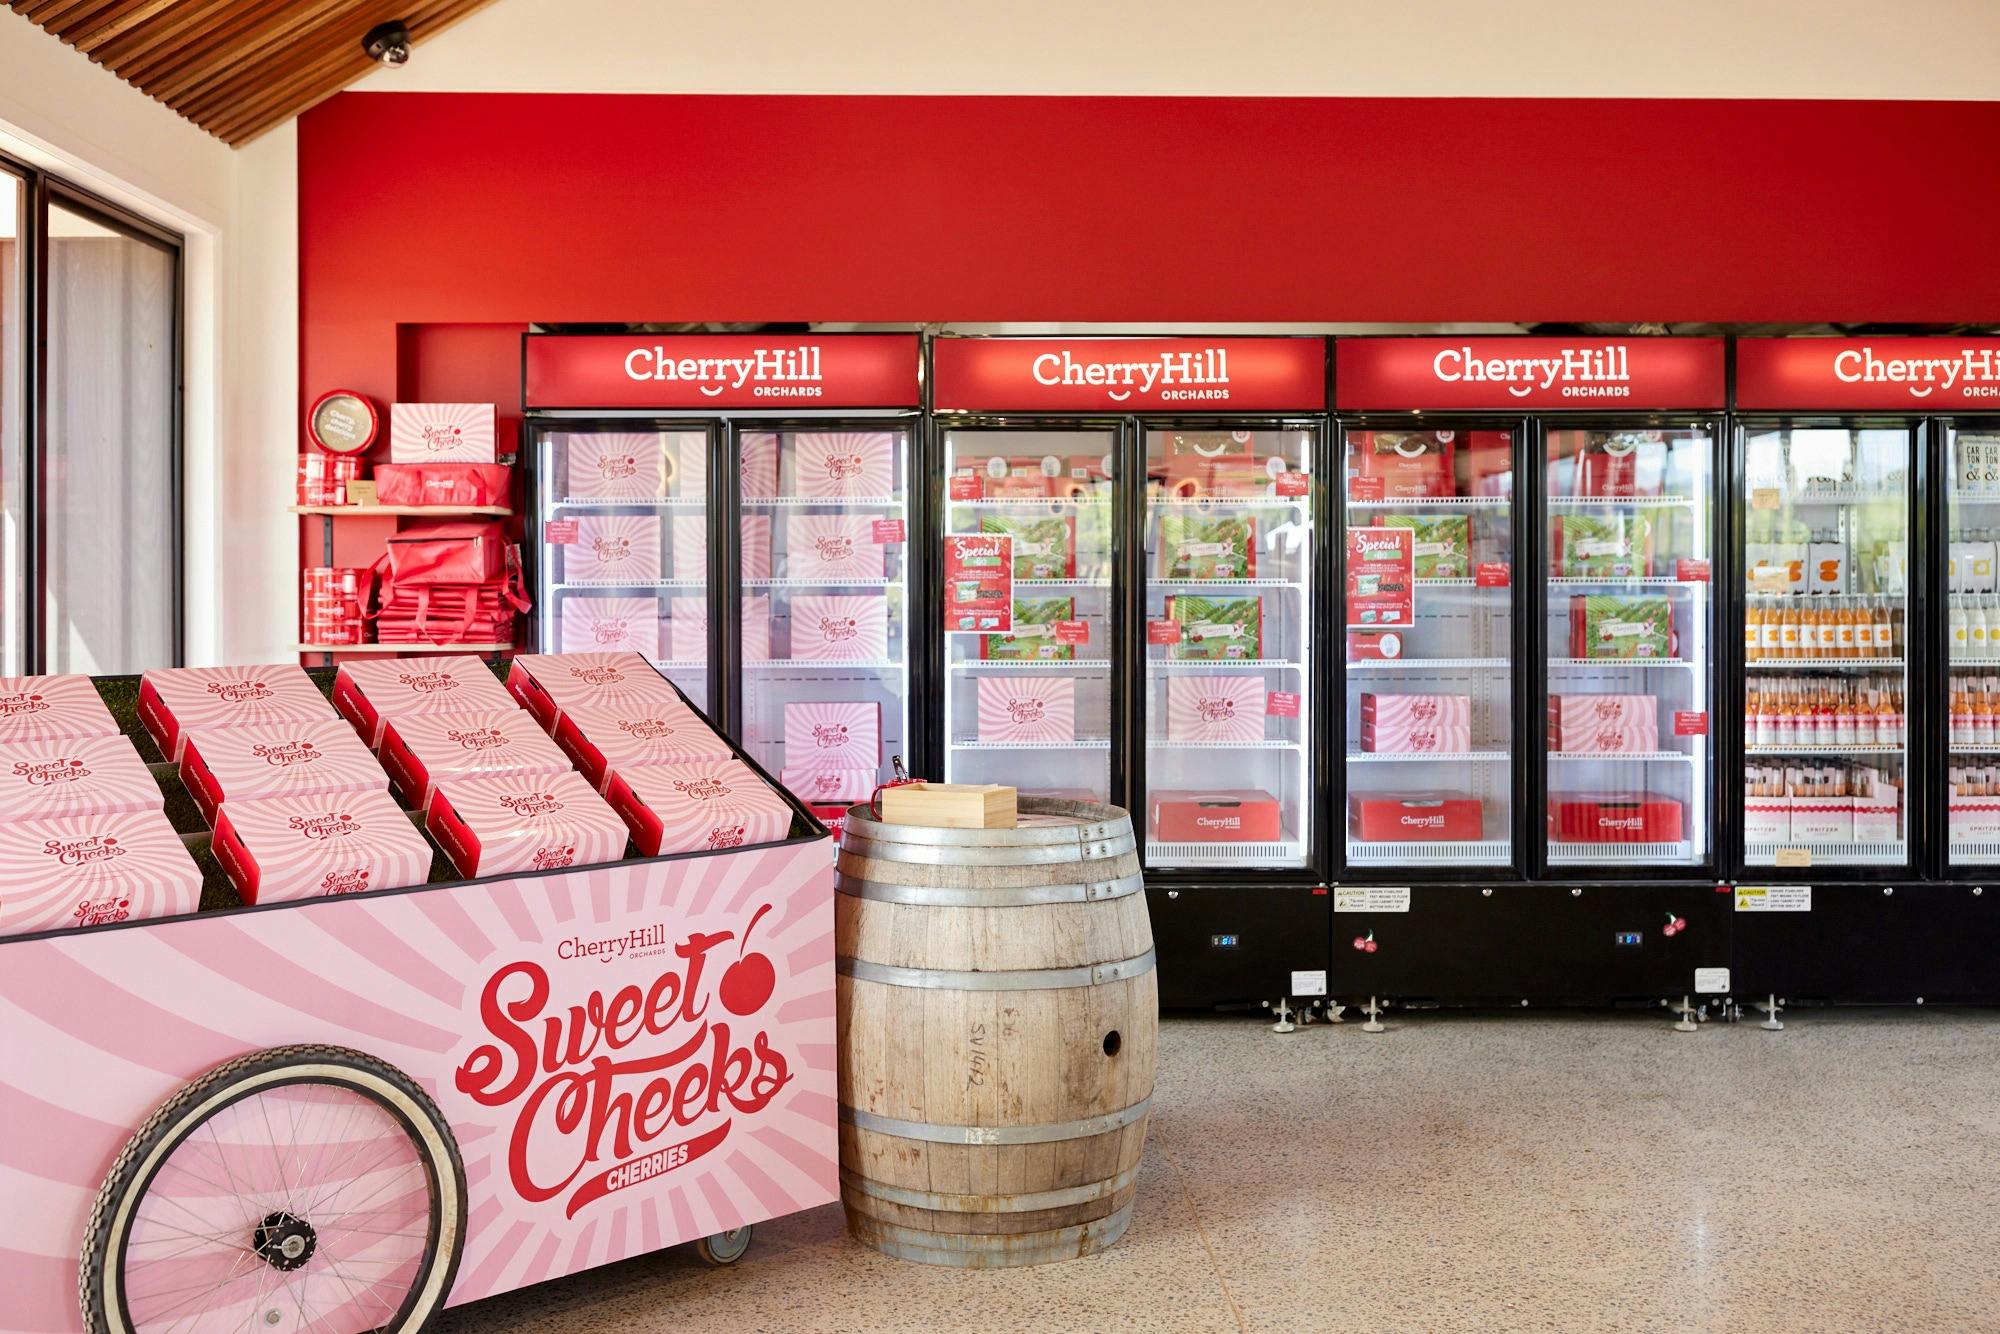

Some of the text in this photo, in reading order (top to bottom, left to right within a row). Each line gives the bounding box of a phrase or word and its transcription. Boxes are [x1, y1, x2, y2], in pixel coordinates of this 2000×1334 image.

[625, 346, 822, 388] CherryHill
[1032, 349, 1229, 392] CherryHill
[1433, 346, 1630, 389] CherryHill
[754, 386, 822, 397] ORCHARDS
[1161, 389, 1230, 401] ORCHARDS
[1562, 386, 1630, 397] ORCHARDS
[955, 540, 1000, 560] Special
[1356, 534, 1401, 553] Special
[208, 681, 254, 694] Sweet
[399, 672, 441, 686] Sweet
[412, 679, 460, 694] Cheeks
[220, 688, 274, 703] Cheeks
[448, 728, 491, 743] Sweet
[461, 736, 510, 751] Cheeks
[253, 741, 302, 758] Sweet
[13, 758, 66, 776] Sweet
[267, 750, 322, 767] Cheeks
[27, 768, 92, 786] Cheeks
[673, 777, 712, 793] Sweet
[500, 793, 544, 809] Sweet
[687, 785, 732, 801] Cheeks
[514, 801, 564, 818] Cheeks
[289, 812, 341, 831] Sweet
[1197, 817, 1241, 828] CherryHill
[1401, 816, 1445, 827] CherryHill
[1598, 818, 1643, 829] CherryHill
[304, 822, 362, 840] Cheeks
[43, 836, 103, 855] Sweet
[59, 845, 127, 865] Cheeks
[321, 869, 362, 889] Sweet
[73, 897, 119, 917] Sweet
[557, 924, 666, 961] CherryHill
[629, 949, 666, 960] ORCHARDS
[455, 930, 735, 1106] Sweet
[508, 1022, 794, 1203] Cheeks
[606, 1144, 689, 1192] CHERRIES
